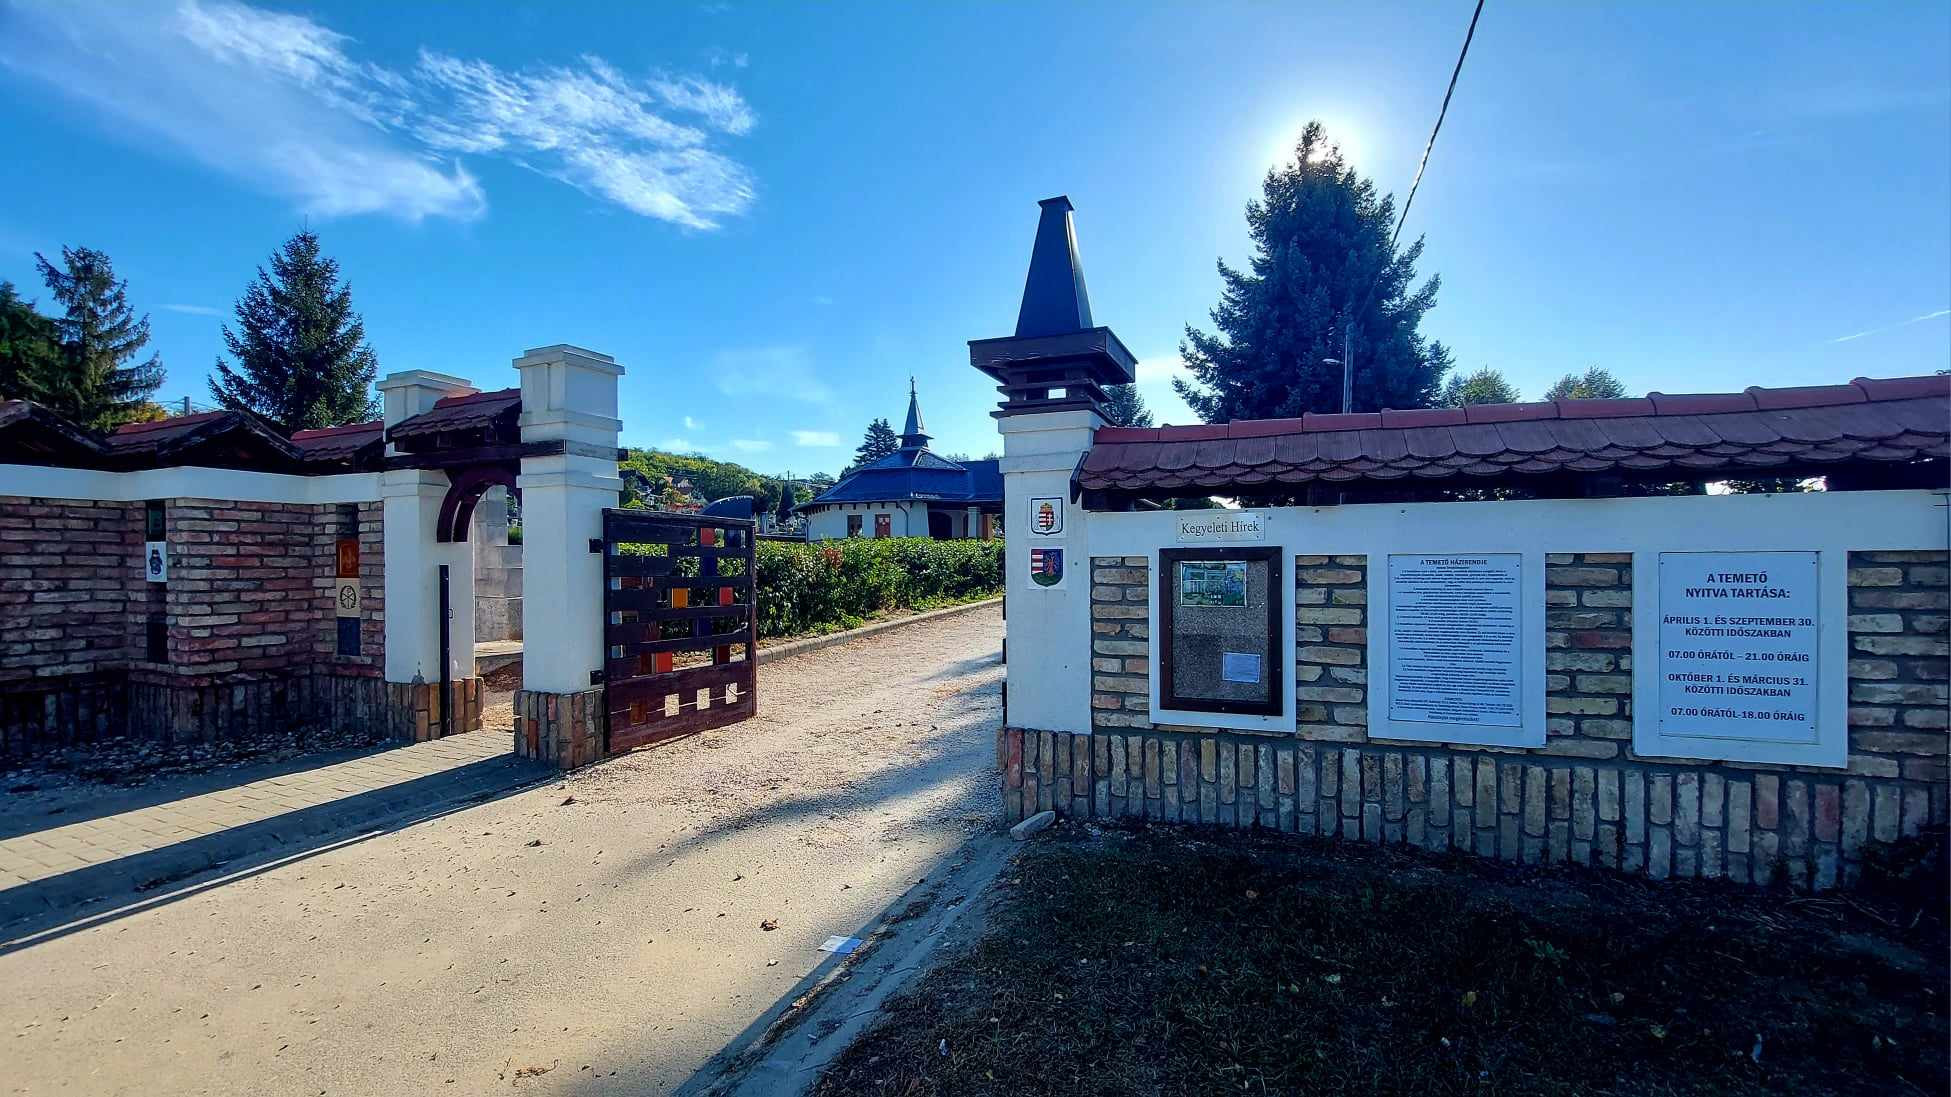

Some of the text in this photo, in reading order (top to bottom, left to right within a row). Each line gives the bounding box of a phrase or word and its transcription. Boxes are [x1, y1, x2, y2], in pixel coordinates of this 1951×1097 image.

[1182, 520, 1260, 536] Kegyeleti Hírek
[1707, 571, 1768, 584] A TEMETŐ
[1686, 585, 1790, 599] NYITVA TARTÁSA:
[1663, 614, 1815, 627] ÁPRILIS 1. ÉS SZEPTEMBER 30.
[1685, 626, 1791, 638] KÖZÖTTI IDŐSZAKBAN
[1669, 650, 1695, 659] 07.00
[1698, 648, 1736, 660] ÓRÁTÓL
[1745, 652, 1775, 661] 21.00
[1777, 651, 1809, 662] ÓRÁIG
[1668, 672, 1809, 686] OKTÓBER 1. ÉS MÁRCIUS 31.
[1727, 685, 1791, 697] IDŐSZAKBAN
[1671, 707, 1698, 716] 07.00
[1773, 710, 1805, 722] ÓRÁIG
